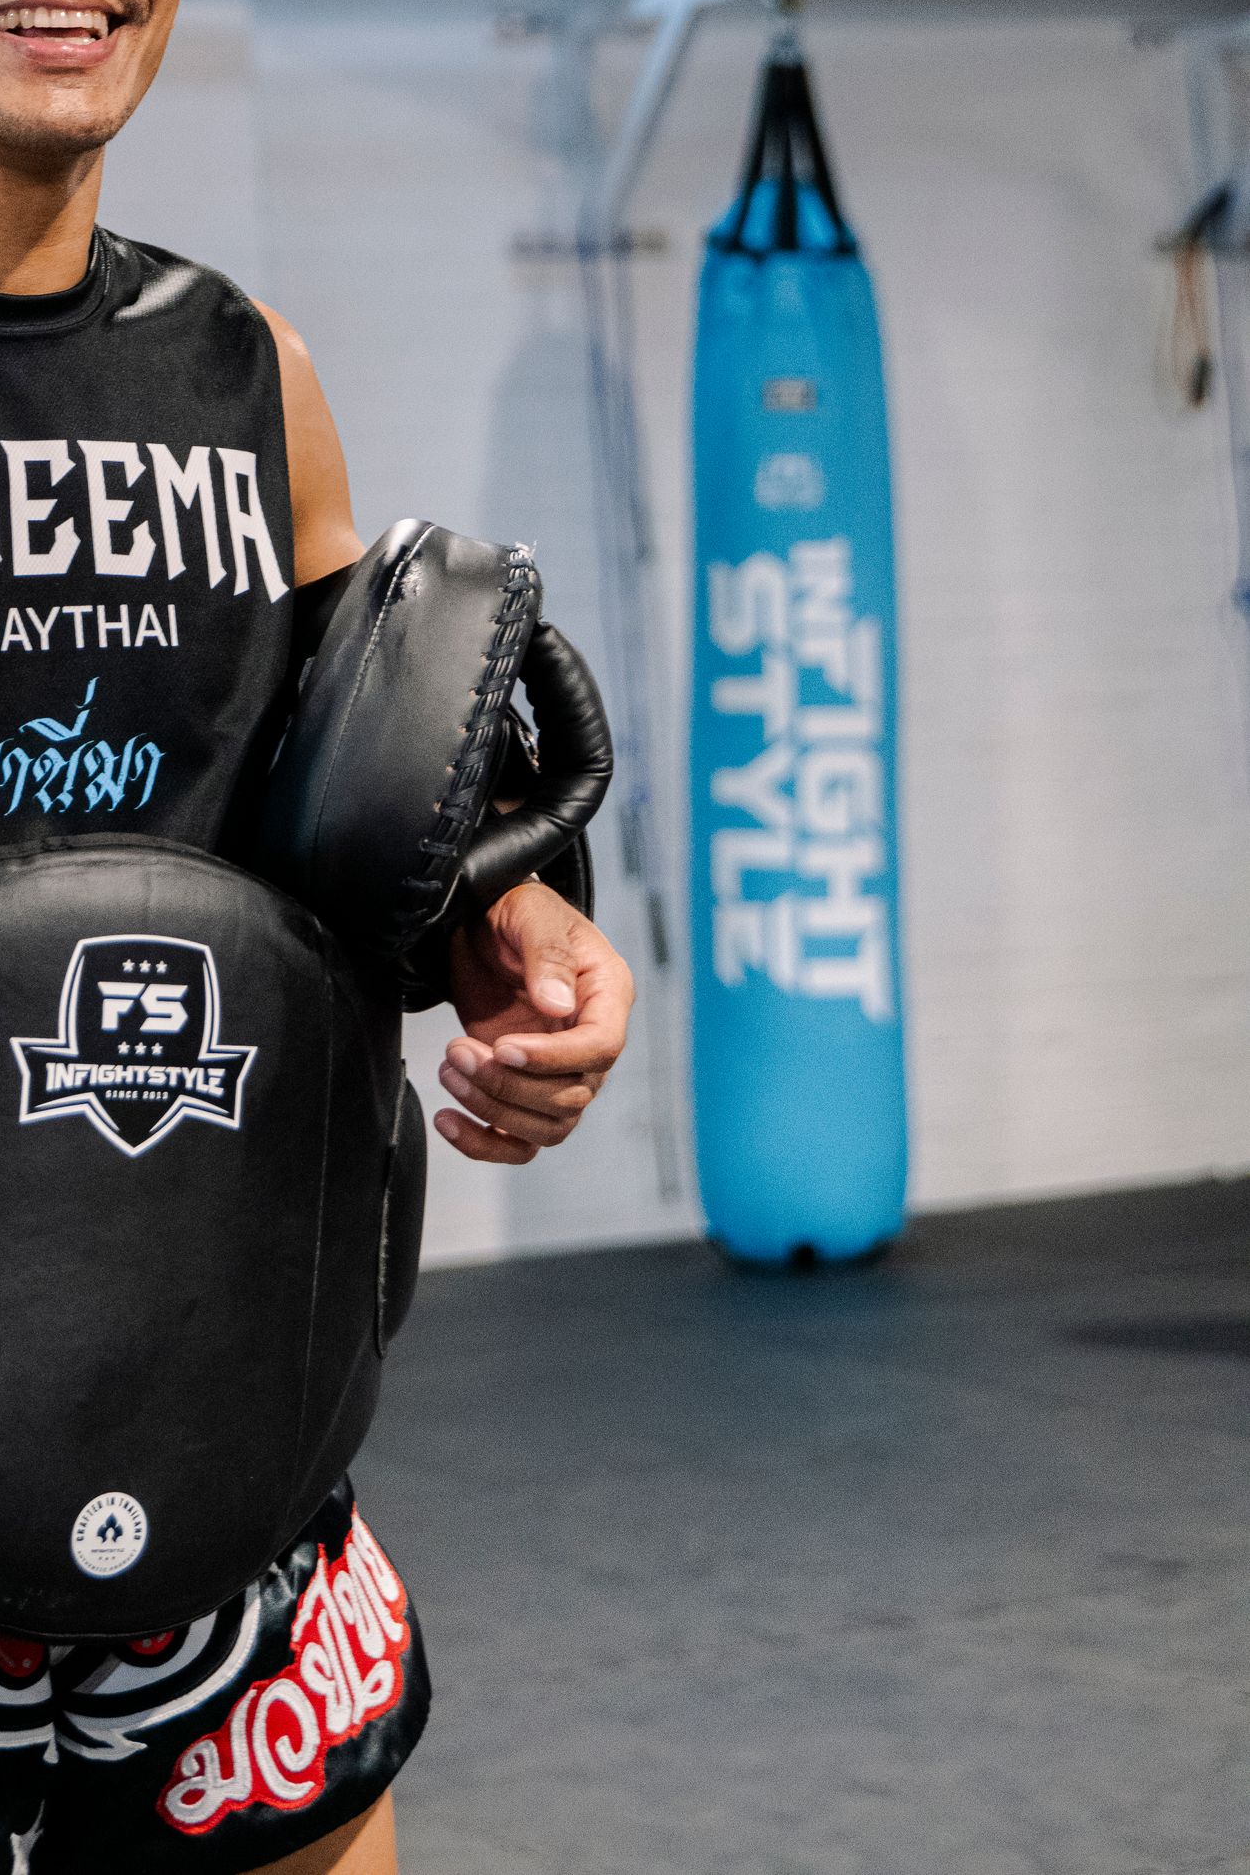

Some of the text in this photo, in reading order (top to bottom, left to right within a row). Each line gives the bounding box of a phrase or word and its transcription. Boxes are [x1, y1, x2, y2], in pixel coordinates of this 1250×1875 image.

[708, 552, 796, 990] STYLE
[98, 981, 188, 1035] FS
[45, 1062, 226, 1098] INFIGHTSTYLE
[105, 1090, 138, 1100] SINCE
